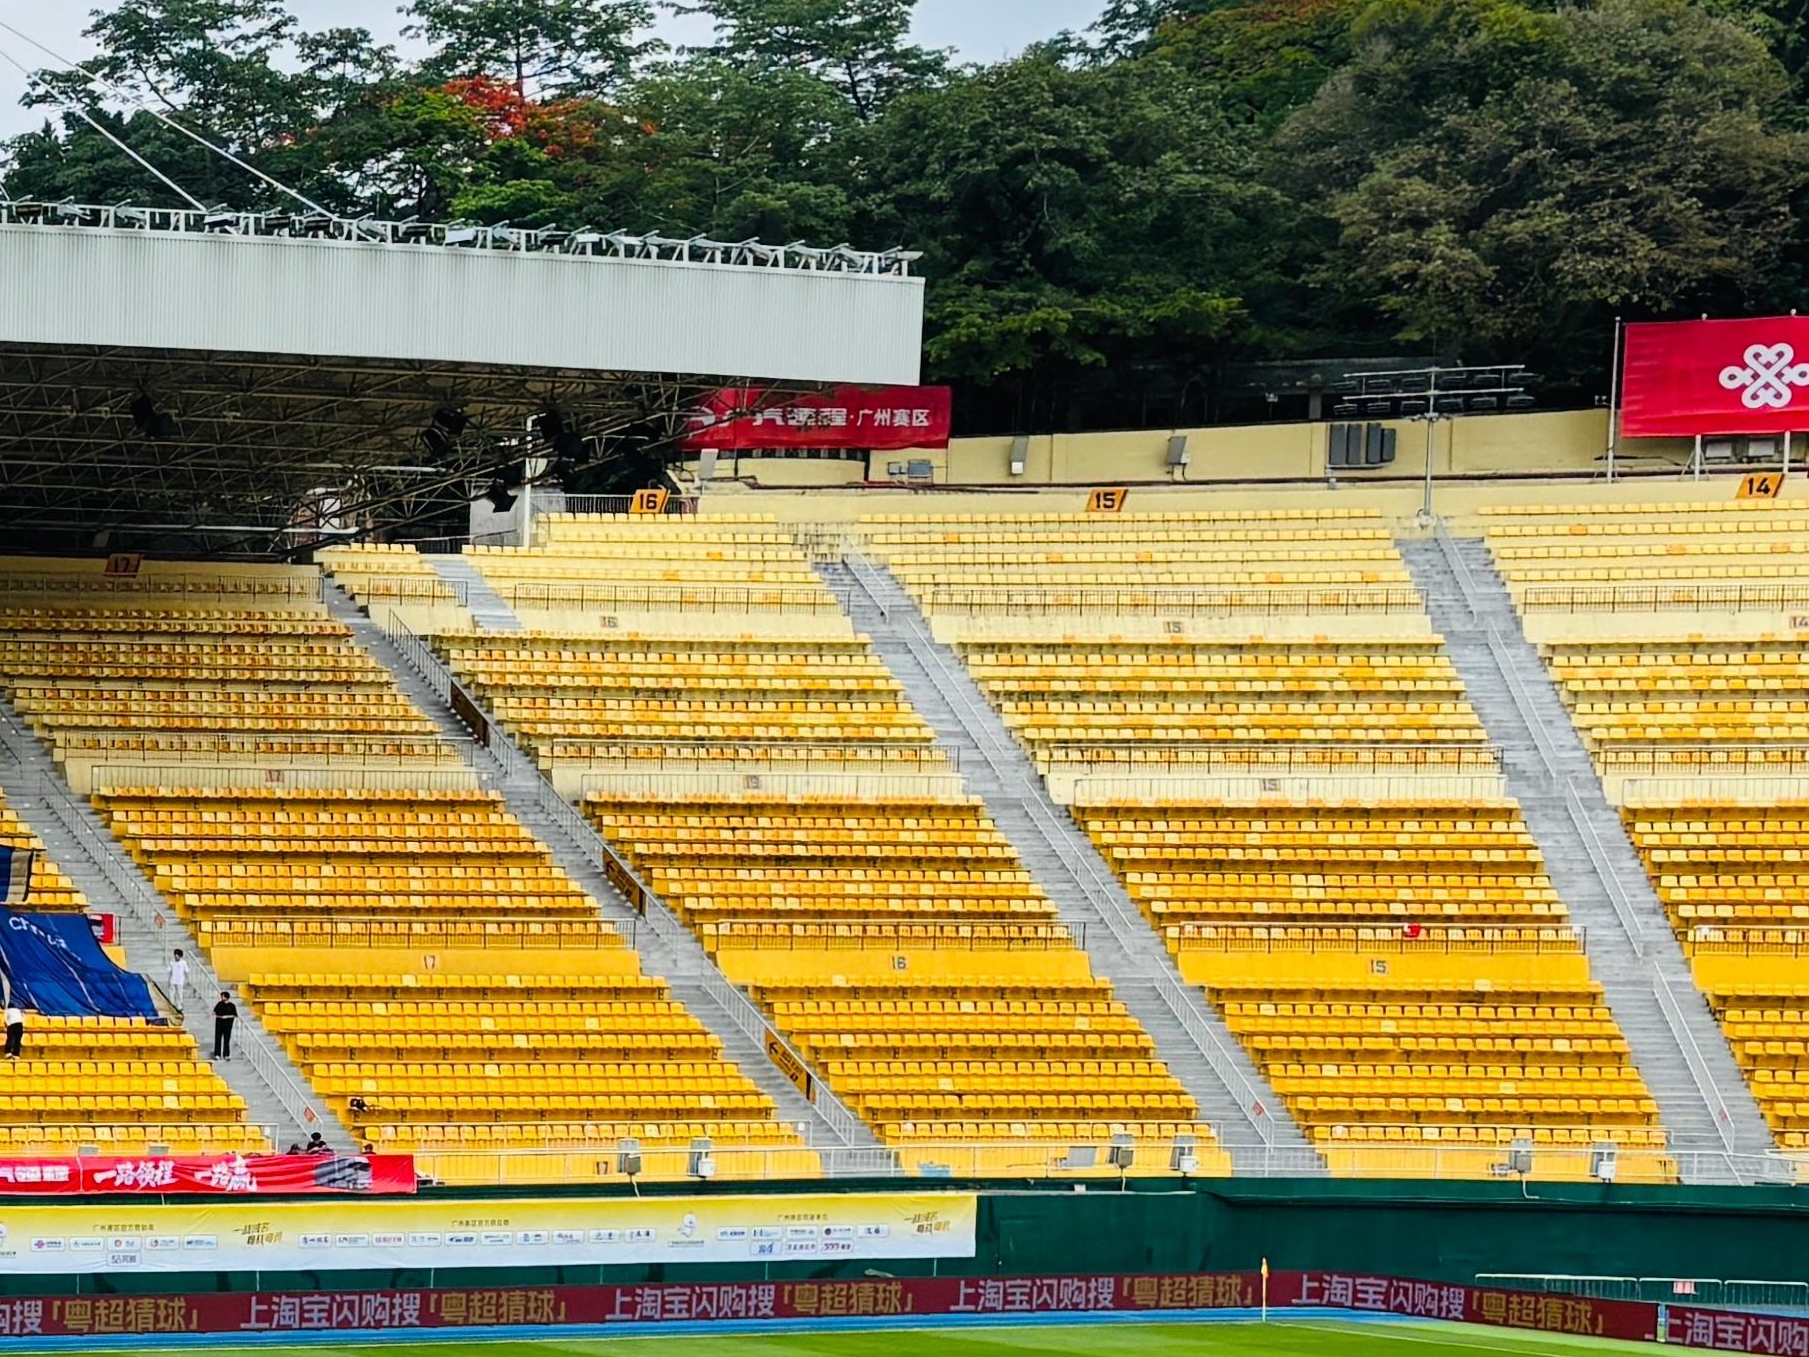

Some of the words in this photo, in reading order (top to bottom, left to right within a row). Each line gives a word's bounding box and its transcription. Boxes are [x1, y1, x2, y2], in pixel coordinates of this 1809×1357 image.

[1748, 478, 1770, 494] 14
[639, 493, 657, 510] 16
[1095, 491, 1116, 508] 15
[1166, 621, 1181, 633] 15
[423, 955, 436, 969] 17
[892, 956, 907, 969] 16
[1371, 959, 1387, 973] 15
